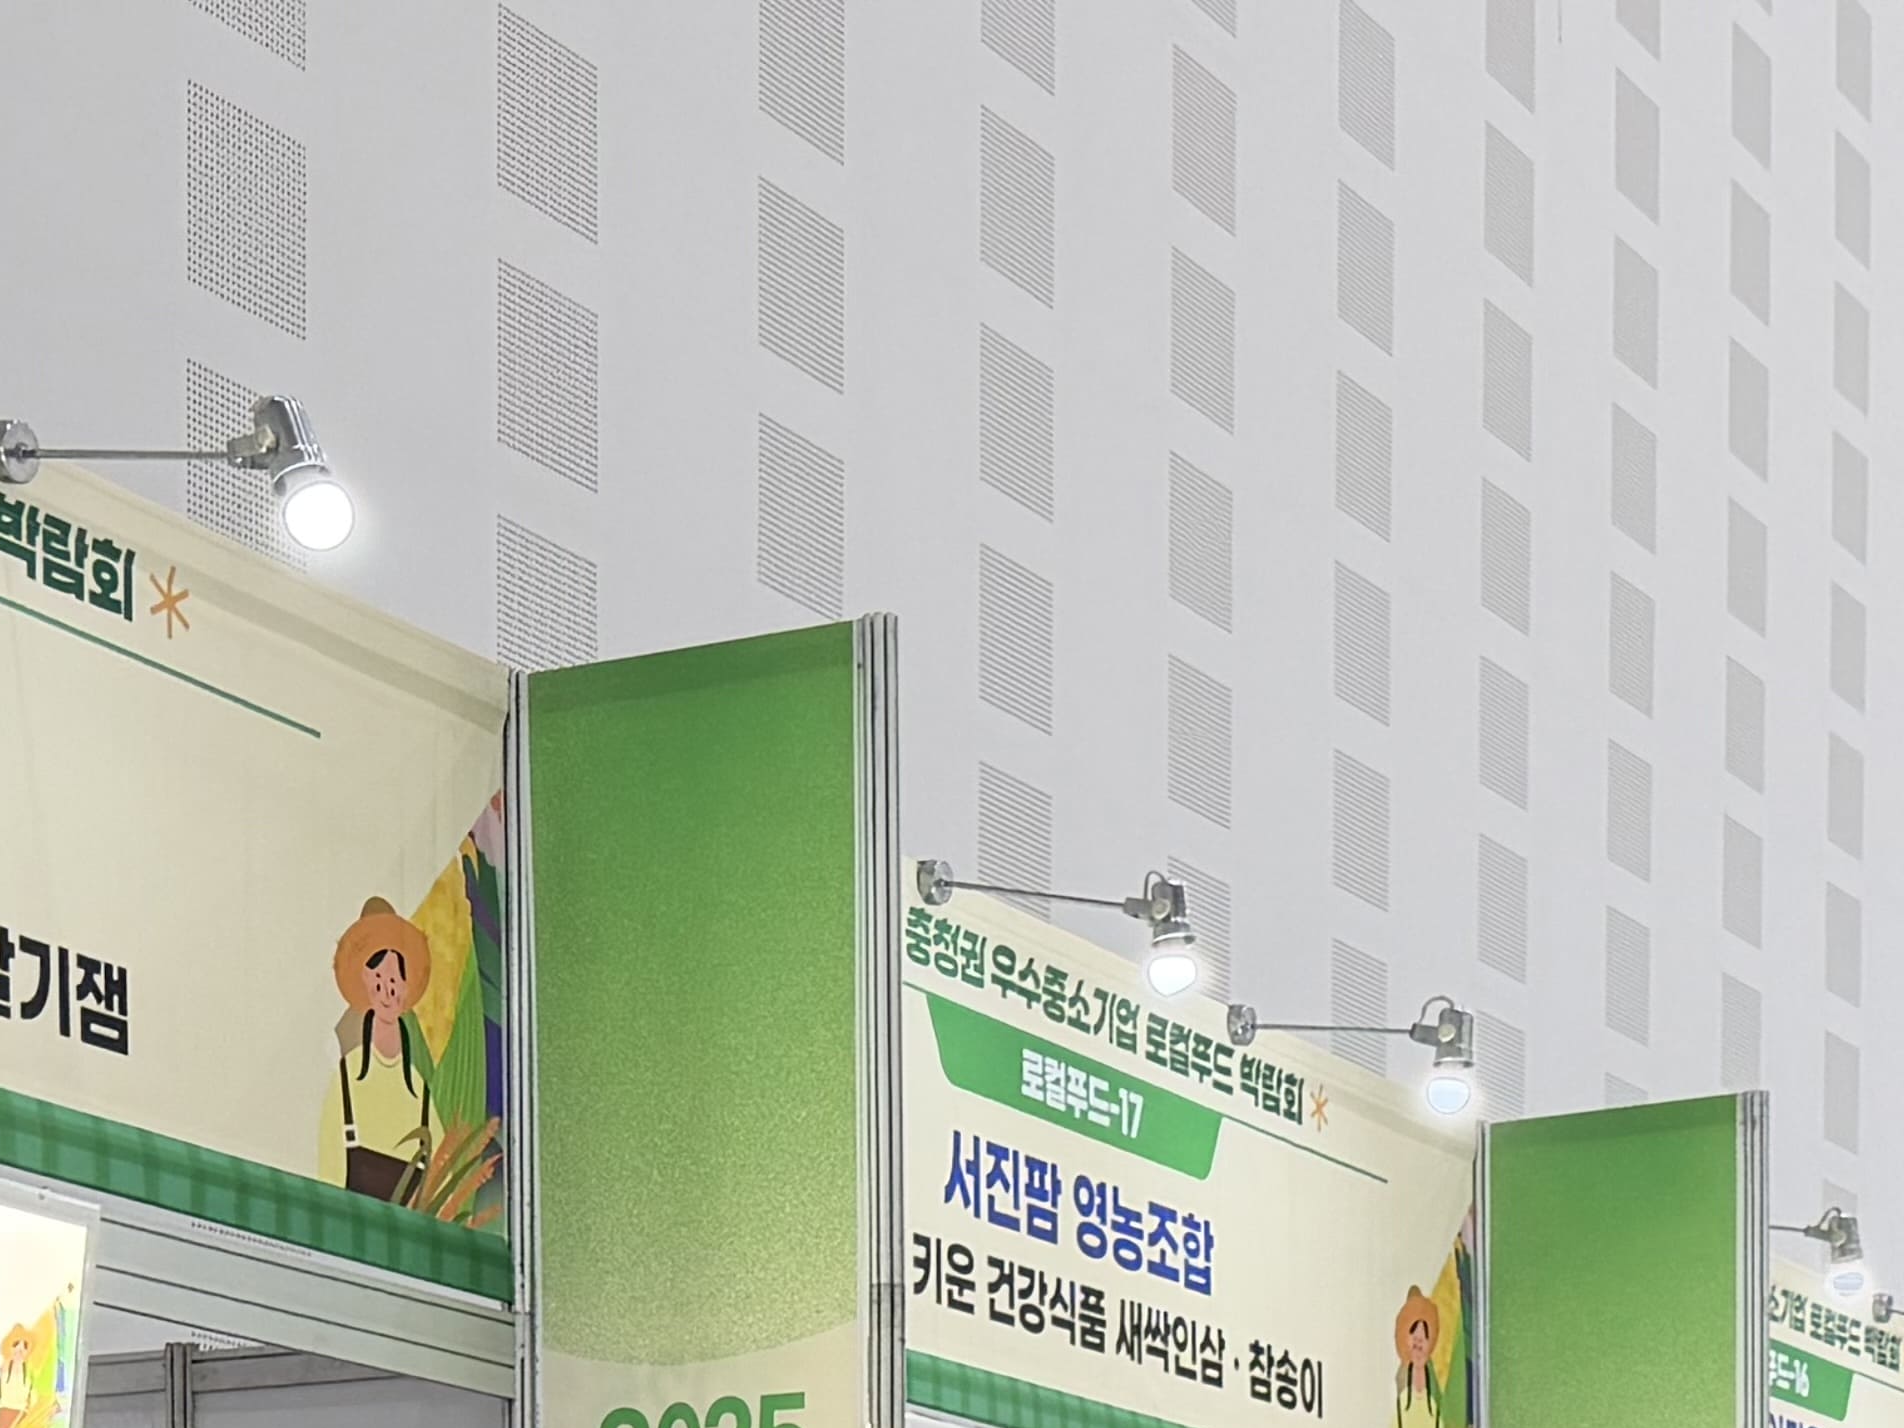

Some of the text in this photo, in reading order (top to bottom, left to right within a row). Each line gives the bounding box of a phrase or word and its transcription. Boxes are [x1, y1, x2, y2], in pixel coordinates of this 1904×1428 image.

[904, 907, 1304, 1126] 충청권 우수중소기업 로컬푸드 박람회
[1021, 1048, 1144, 1139] 로컬푸드-17
[944, 1130, 1214, 1296] 서진팜 영농조합
[912, 1233, 1325, 1420] 키운 건강식품 새싹인삼 참송이
